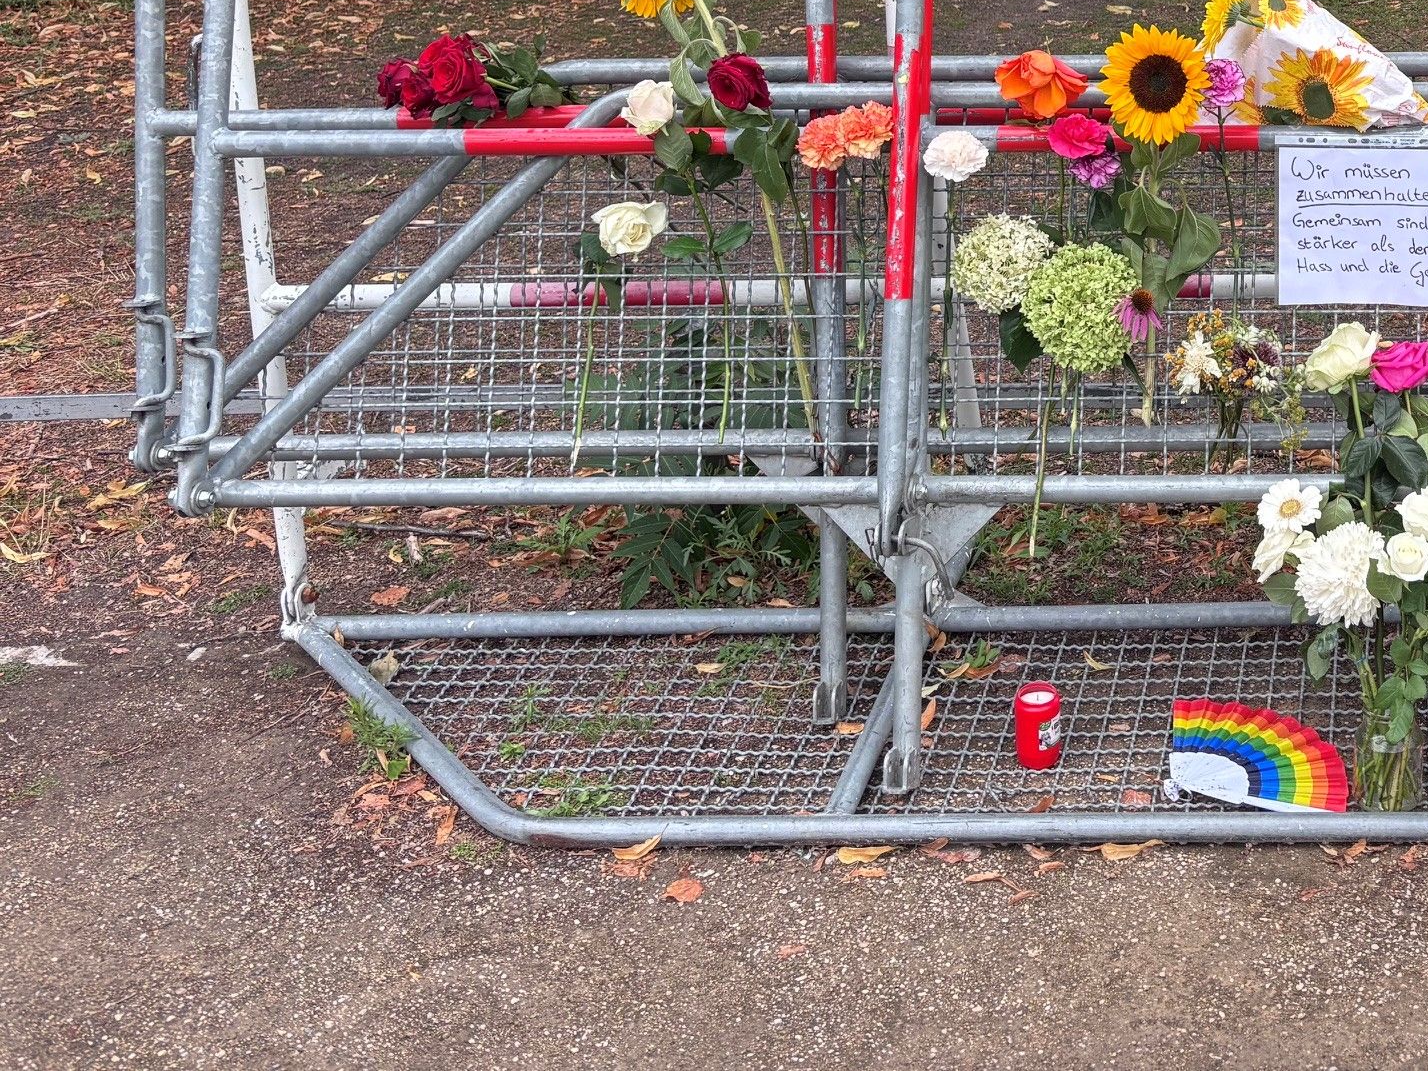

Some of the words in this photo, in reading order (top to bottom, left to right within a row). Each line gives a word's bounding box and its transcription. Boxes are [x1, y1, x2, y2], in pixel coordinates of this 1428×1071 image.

[1291, 156, 1330, 181] Wir
[1344, 163, 1411, 179] müssen
[1292, 213, 1382, 228] Gemeinsam
[1396, 216, 1428, 230] sind
[1297, 235, 1358, 250] stärker
[1371, 234, 1395, 252] als
[1296, 257, 1333, 273] Hass
[1340, 257, 1370, 273] und
[1378, 259, 1401, 274] die
